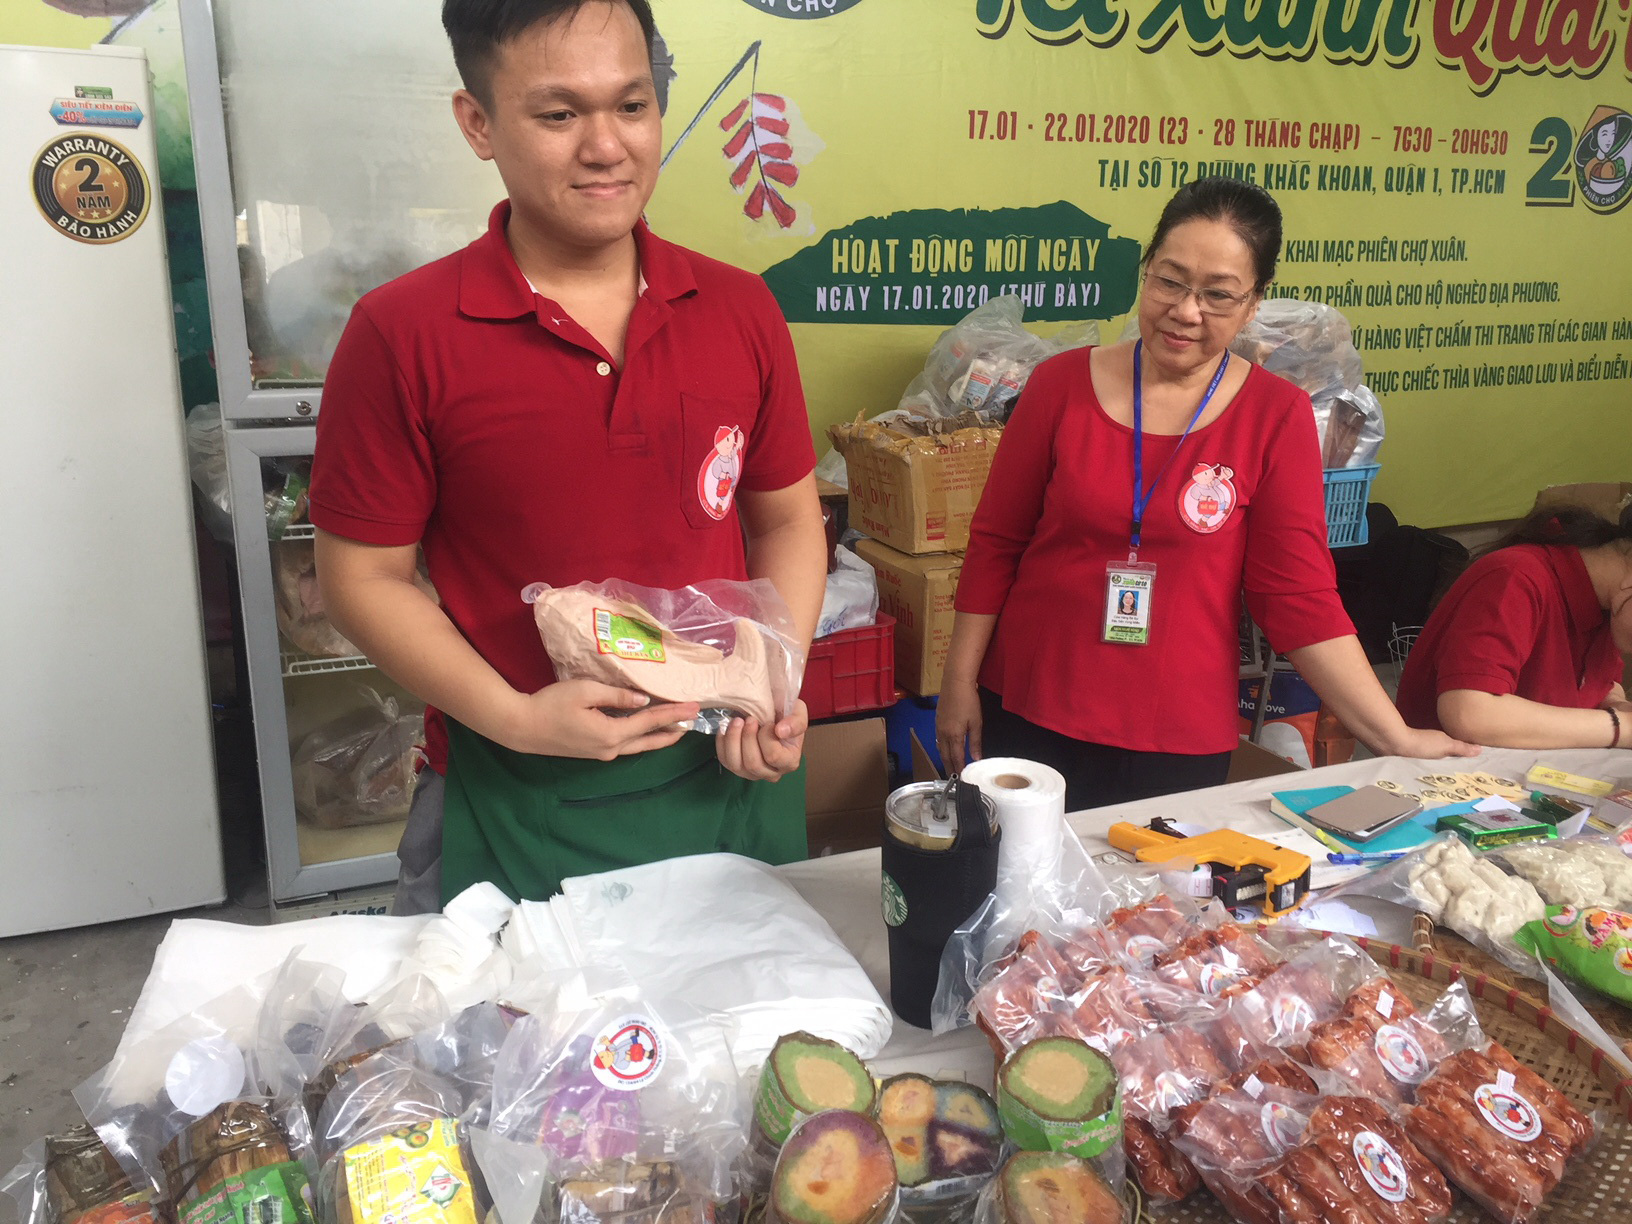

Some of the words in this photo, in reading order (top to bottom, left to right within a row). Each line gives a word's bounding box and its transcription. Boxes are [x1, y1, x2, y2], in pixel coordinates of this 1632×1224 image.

[58, 111, 88, 123] -40%
[968, 109, 1018, 141] 17.01
[1044, 112, 1151, 144] 22.01.2020
[1159, 116, 1189, 145] (23
[1213, 118, 1236, 146] 28
[1309, 122, 1361, 153] CHẠP)
[1393, 126, 1433, 153] 7G30
[1451, 128, 1509, 156] 20HG30
[42, 138, 129, 168] WARRANTY
[75, 158, 104, 192] 2
[1098, 159, 1129, 191] TẠI
[1171, 161, 1189, 188] 12
[1317, 165, 1377, 195] KHOAN,
[1384, 163, 1426, 196] QUẬN
[1433, 168, 1442, 196] 1,
[1451, 168, 1506, 195] TP.HCM
[57, 215, 92, 237] BẢO
[96, 210, 138, 238] HÀNH
[832, 235, 899, 277] HOẠT
[909, 234, 973, 277] ĐỘNG
[1037, 236, 1101, 272] NGÀY
[1285, 240, 1320, 262] KHAI
[1322, 240, 1354, 267] MẠC
[1357, 236, 1398, 262] PHIÊN
[1401, 239, 1428, 266] CHỢ
[1430, 236, 1468, 262] XUÂN.
[816, 283, 870, 312] NGÀY
[882, 285, 989, 311] 17.01.2020
[1054, 278, 1101, 308] BẢY)
[1303, 286, 1322, 304] 20
[1325, 279, 1363, 307] PHẦN
[1366, 280, 1392, 307] QUÀ
[1395, 284, 1422, 306] CHO
[1425, 280, 1443, 309] HỘ
[1445, 279, 1487, 304] NGHÈO
[1489, 282, 1509, 307] ĐỊA
[1511, 281, 1561, 304] PHƯƠNG.
[1350, 325, 1363, 351] Ứ
[1364, 325, 1401, 350] HÀNG
[1405, 323, 1433, 352] VIỆT
[1435, 320, 1472, 348] CHẤM
[1475, 325, 1494, 346] THI
[1497, 324, 1535, 345] TRANG
[1538, 319, 1557, 343] TRÍ
[1557, 318, 1580, 342] CÁC
[1581, 321, 1608, 342] GIAN
[1365, 371, 1399, 397] THỰC
[1402, 363, 1440, 391] CHIẾC
[1443, 364, 1470, 389] THÌA
[1473, 363, 1505, 387] VÀNG
[1507, 364, 1534, 385] GIAO
[1535, 363, 1558, 384] LƯU
[1560, 358, 1574, 382] VÀ
[1576, 353, 1602, 382] BIỂU
[1602, 353, 1629, 380] DIỄN
[1238, 698, 1286, 715] haove
